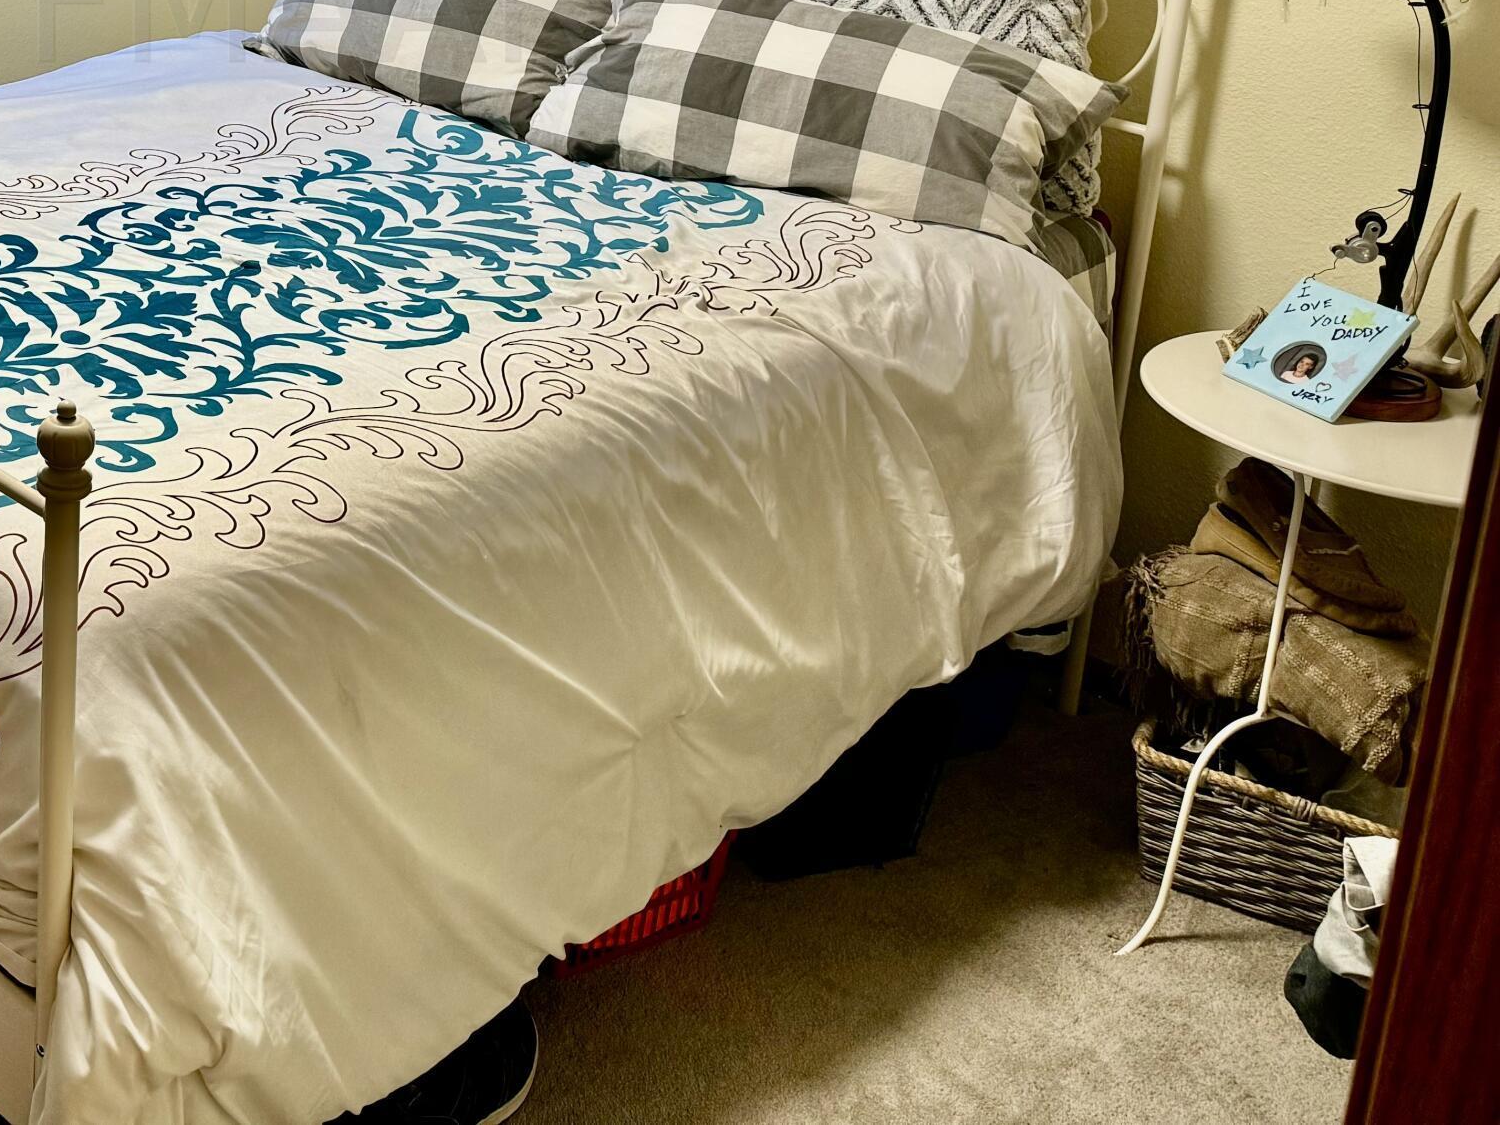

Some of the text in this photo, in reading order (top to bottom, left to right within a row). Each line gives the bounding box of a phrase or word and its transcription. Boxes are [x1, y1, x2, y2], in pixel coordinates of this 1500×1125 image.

[1298, 286, 1311, 298] I
[1283, 299, 1333, 313] LOVE
[1310, 315, 1347, 328] YOU
[1331, 325, 1389, 343] DADDY
